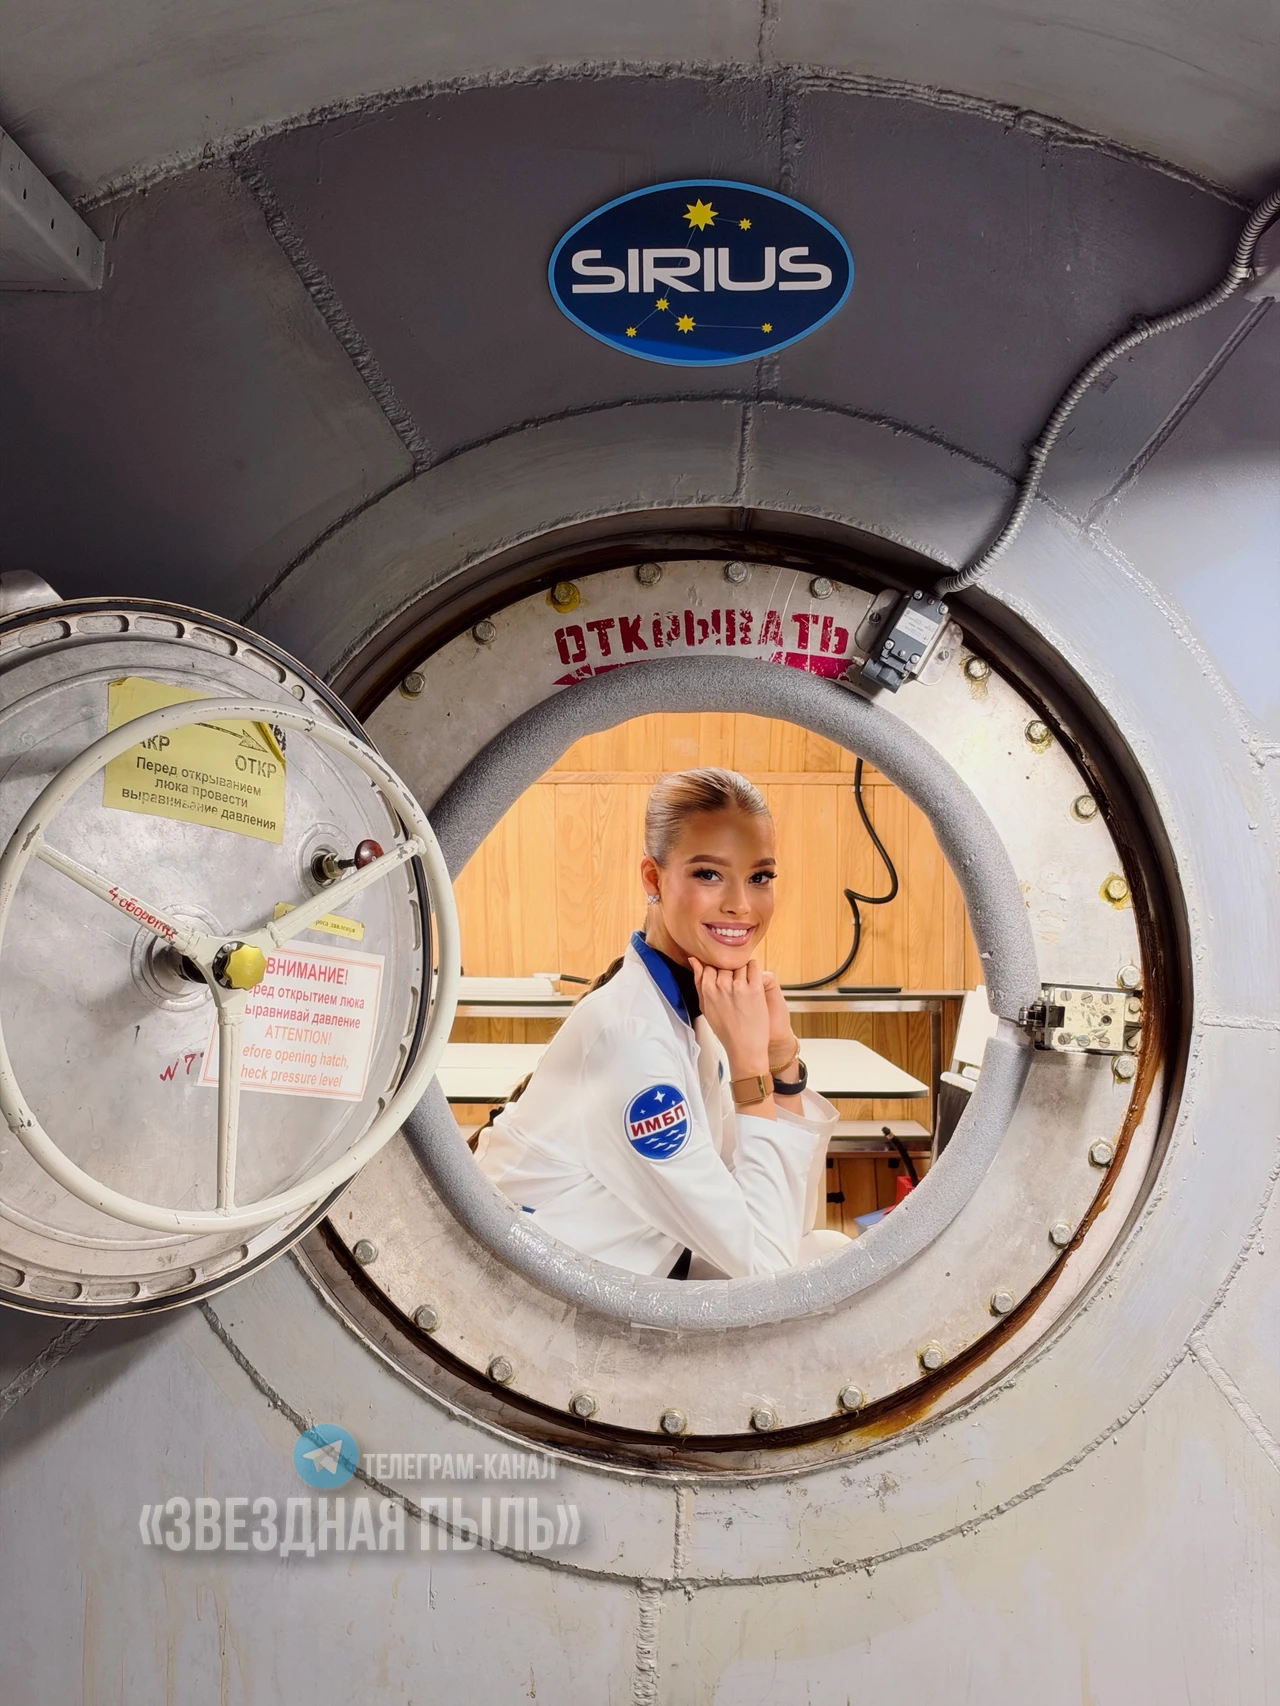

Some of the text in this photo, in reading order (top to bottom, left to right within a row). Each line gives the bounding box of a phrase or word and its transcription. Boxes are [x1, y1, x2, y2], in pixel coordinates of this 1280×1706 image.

[571, 246, 832, 294] SIRIUS
[553, 608, 850, 665] ОТКРЫВАТЬ
[139, 735, 170, 751] КР
[136, 756, 262, 797] Перед открыванием
[234, 754, 277, 779] ОТКР
[154, 778, 249, 808] люка провести
[121, 788, 276, 831] выравнивание давления
[108, 886, 119, 902] 4
[265, 956, 349, 986] ВНИМАНИЕ!
[249, 984, 365, 1009] ред открытием люка
[244, 1003, 361, 1029] ыравнивай давление
[264, 1024, 332, 1046] ATTENTION!
[242, 1043, 349, 1070] efore opening hatch,
[240, 1064, 343, 1088] heck pressure level
[630, 1104, 686, 1137] ИМБП
